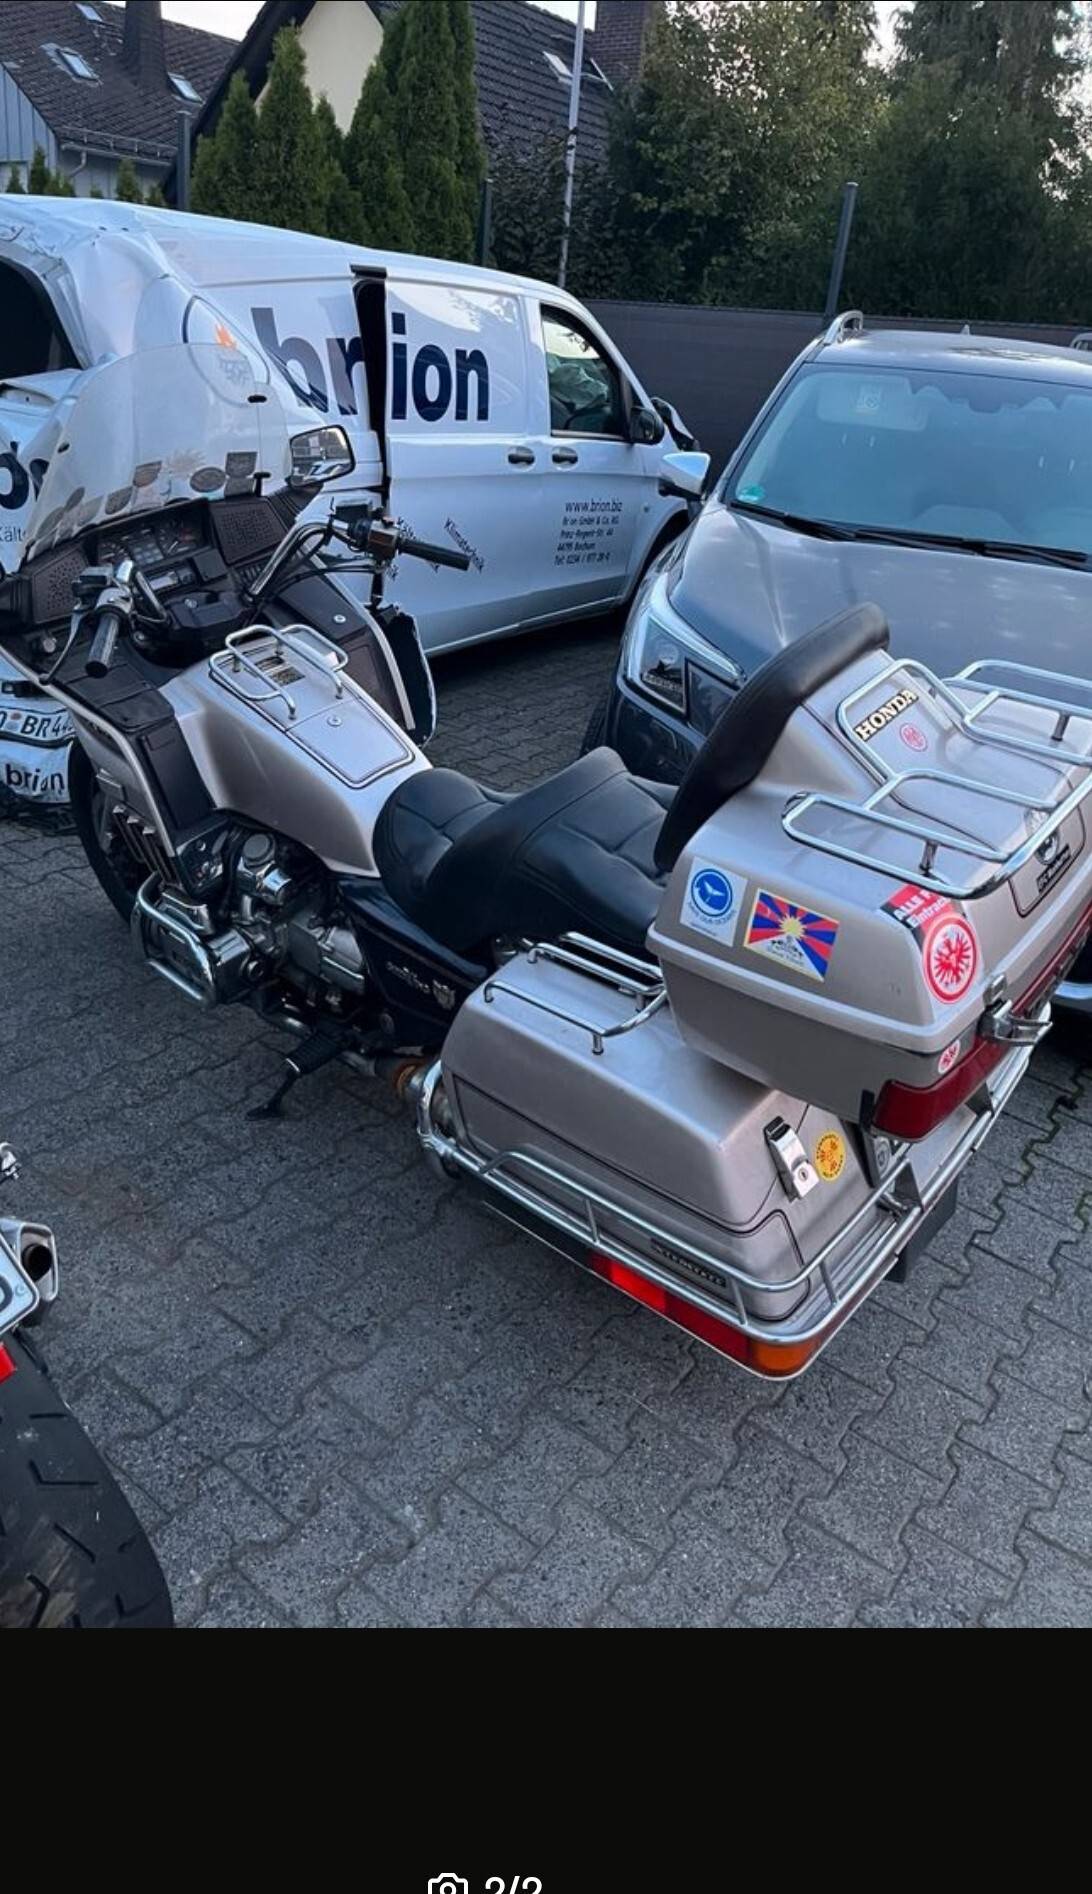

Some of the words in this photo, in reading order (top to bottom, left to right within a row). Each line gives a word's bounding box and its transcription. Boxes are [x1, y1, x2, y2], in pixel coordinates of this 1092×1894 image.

[251, 307, 489, 422] brion
[855, 689, 918, 741] HONDA
[5, 762, 65, 792] brion
